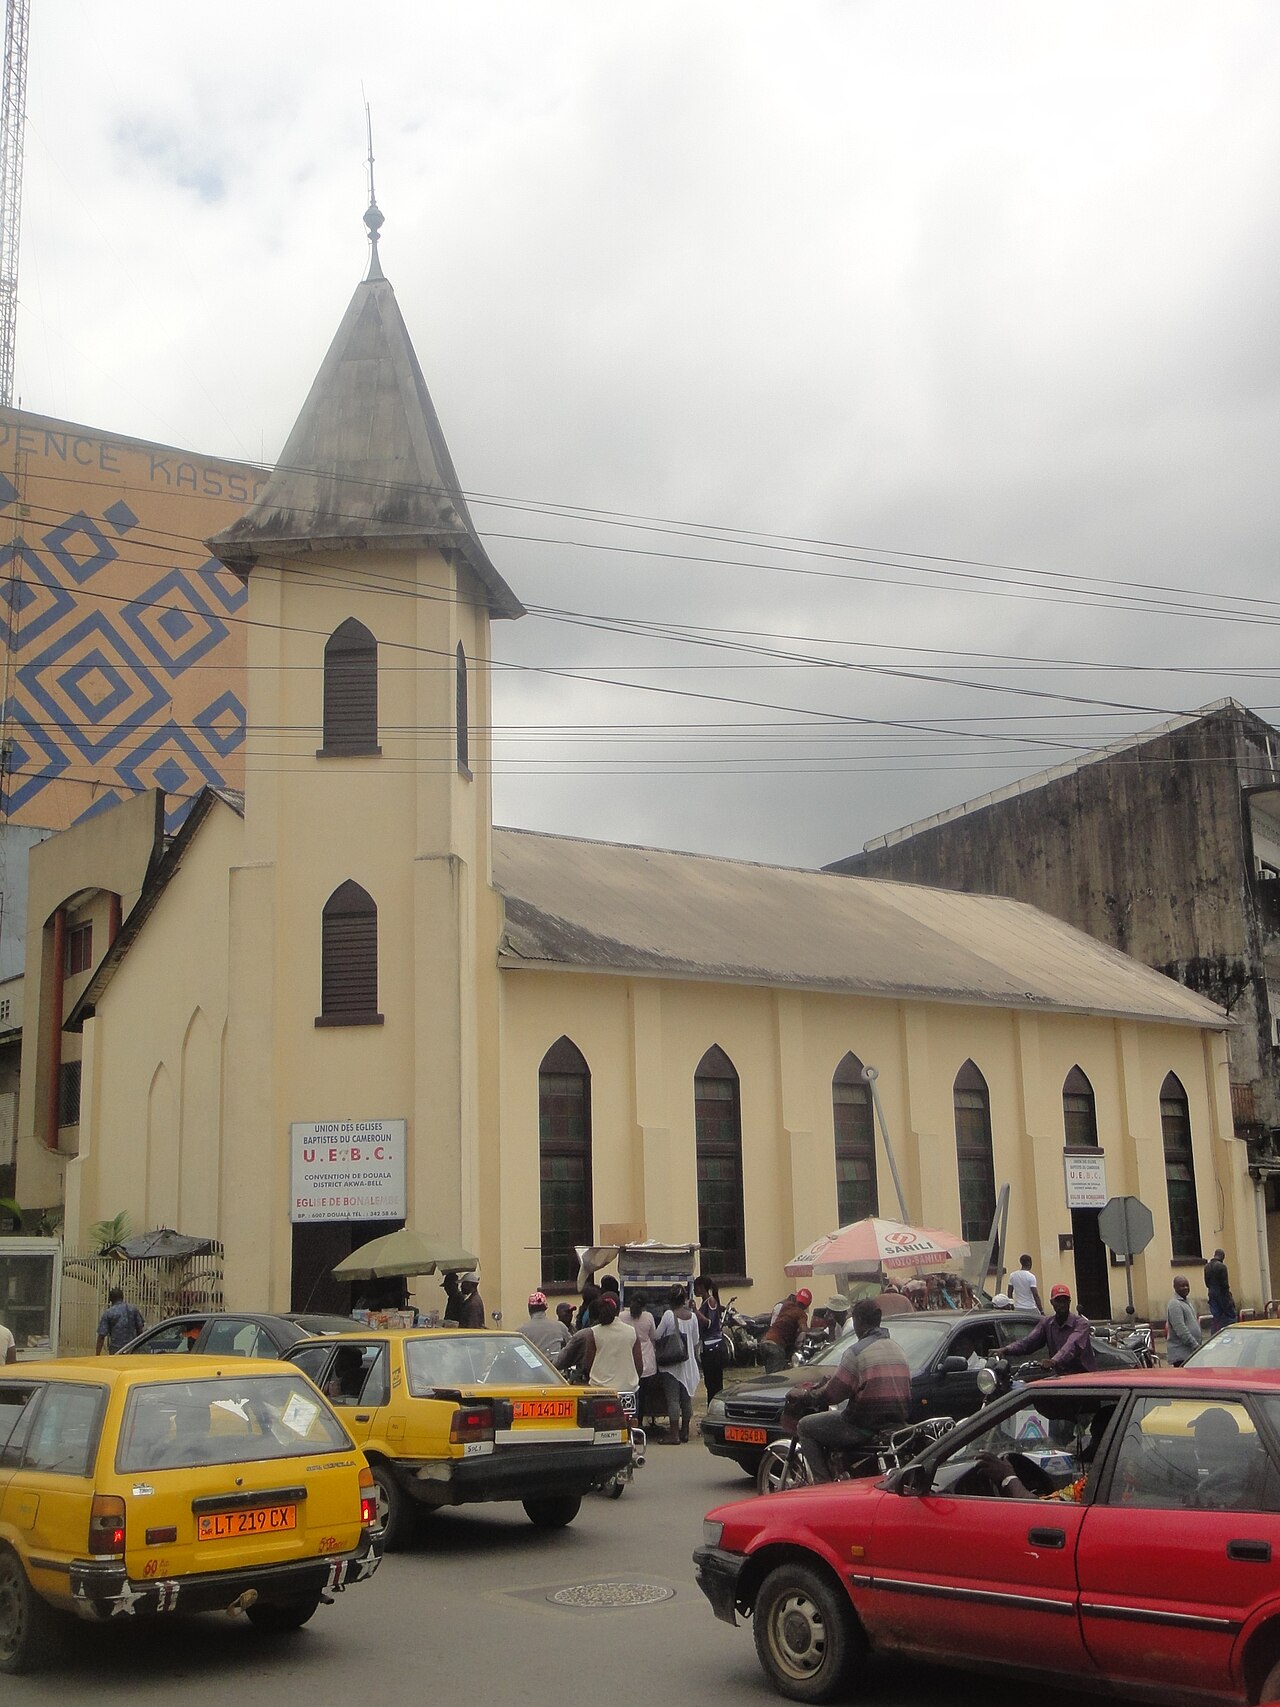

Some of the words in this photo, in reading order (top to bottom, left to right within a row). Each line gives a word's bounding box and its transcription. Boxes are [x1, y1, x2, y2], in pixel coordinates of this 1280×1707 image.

[314, 1124, 339, 1133] UNION
[341, 1123, 354, 1132] DES
[356, 1122, 383, 1131] EGLISES
[303, 1136, 338, 1144] BAPTISTES
[340, 1135, 350, 1143] DU
[352, 1134, 392, 1143] CAMEROUN
[329, 1197, 341, 1206] DE
[885, 1242, 934, 1255] SANILI
[887, 1254, 943, 1267] MOTO-SANILI
[522, 1403, 536, 1416] LT
[537, 1403, 555, 1416] 141
[557, 1402, 571, 1416] DH
[213, 1514, 233, 1535] LT
[238, 1511, 267, 1532] 219
[270, 1508, 289, 1527] CX
